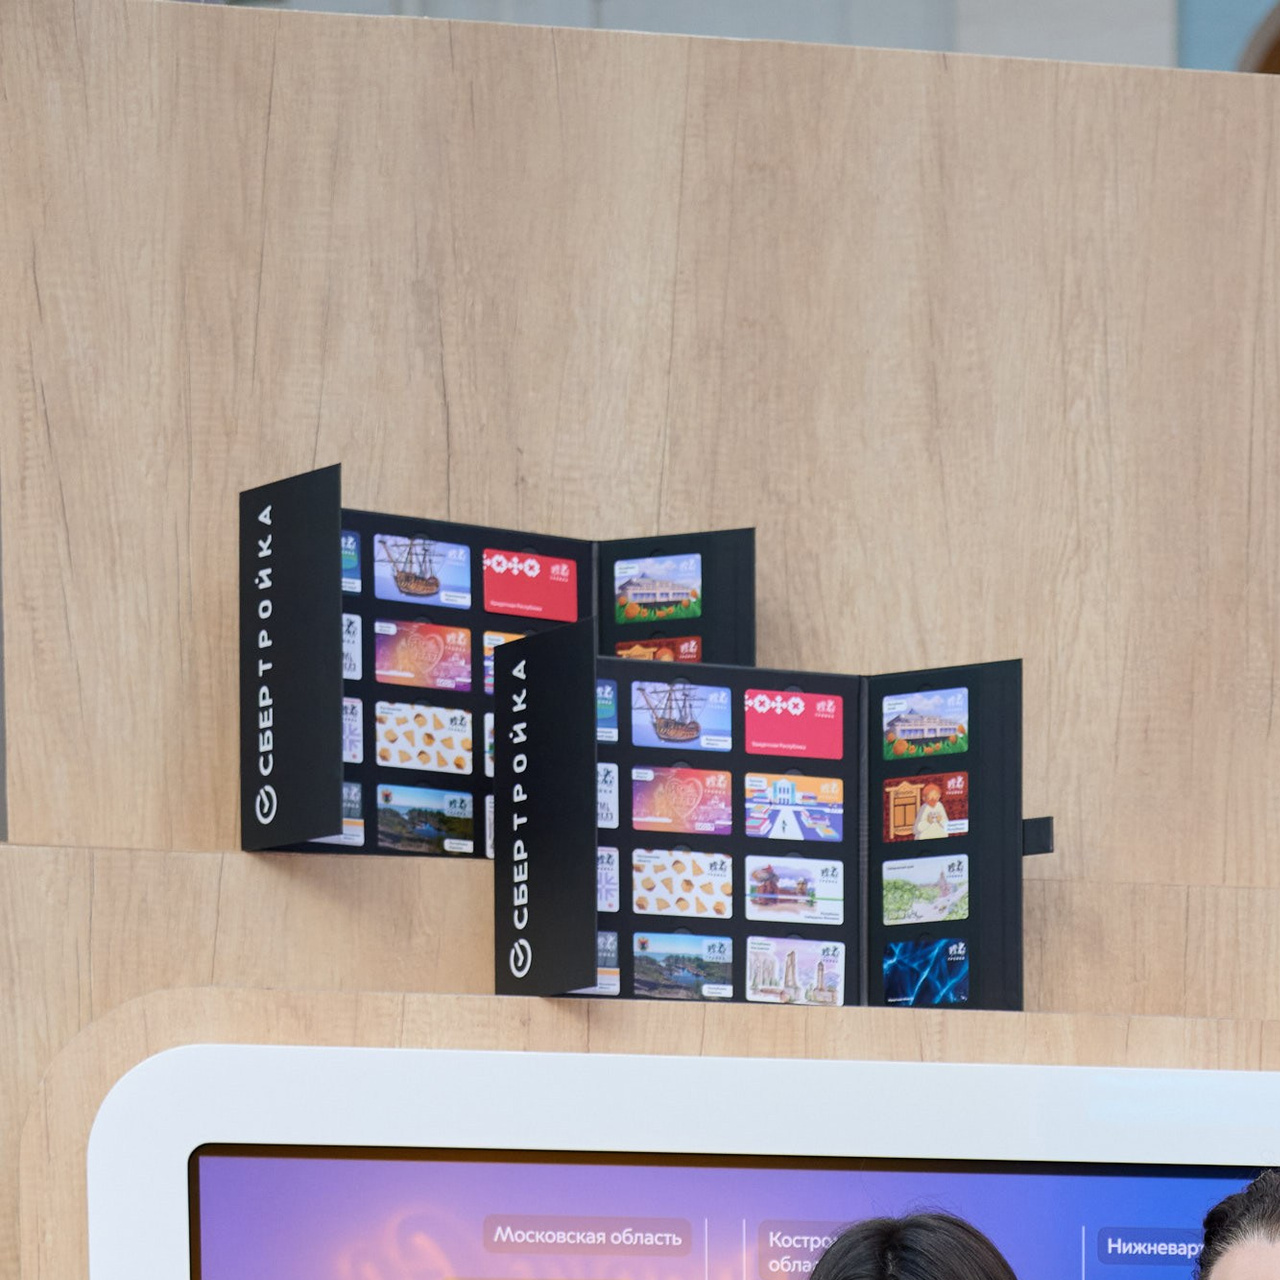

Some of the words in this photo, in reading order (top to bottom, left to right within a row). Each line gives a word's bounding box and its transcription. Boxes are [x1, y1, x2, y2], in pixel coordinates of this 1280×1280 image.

[254, 504, 275, 778] СБЕРТРОЙКА
[508, 658, 530, 931] СБЕРТРОЙКА
[493, 1226, 606, 1245] Московская
[609, 1227, 683, 1246] область
[768, 1231, 838, 1252] Костро
[768, 1255, 815, 1273] обла
